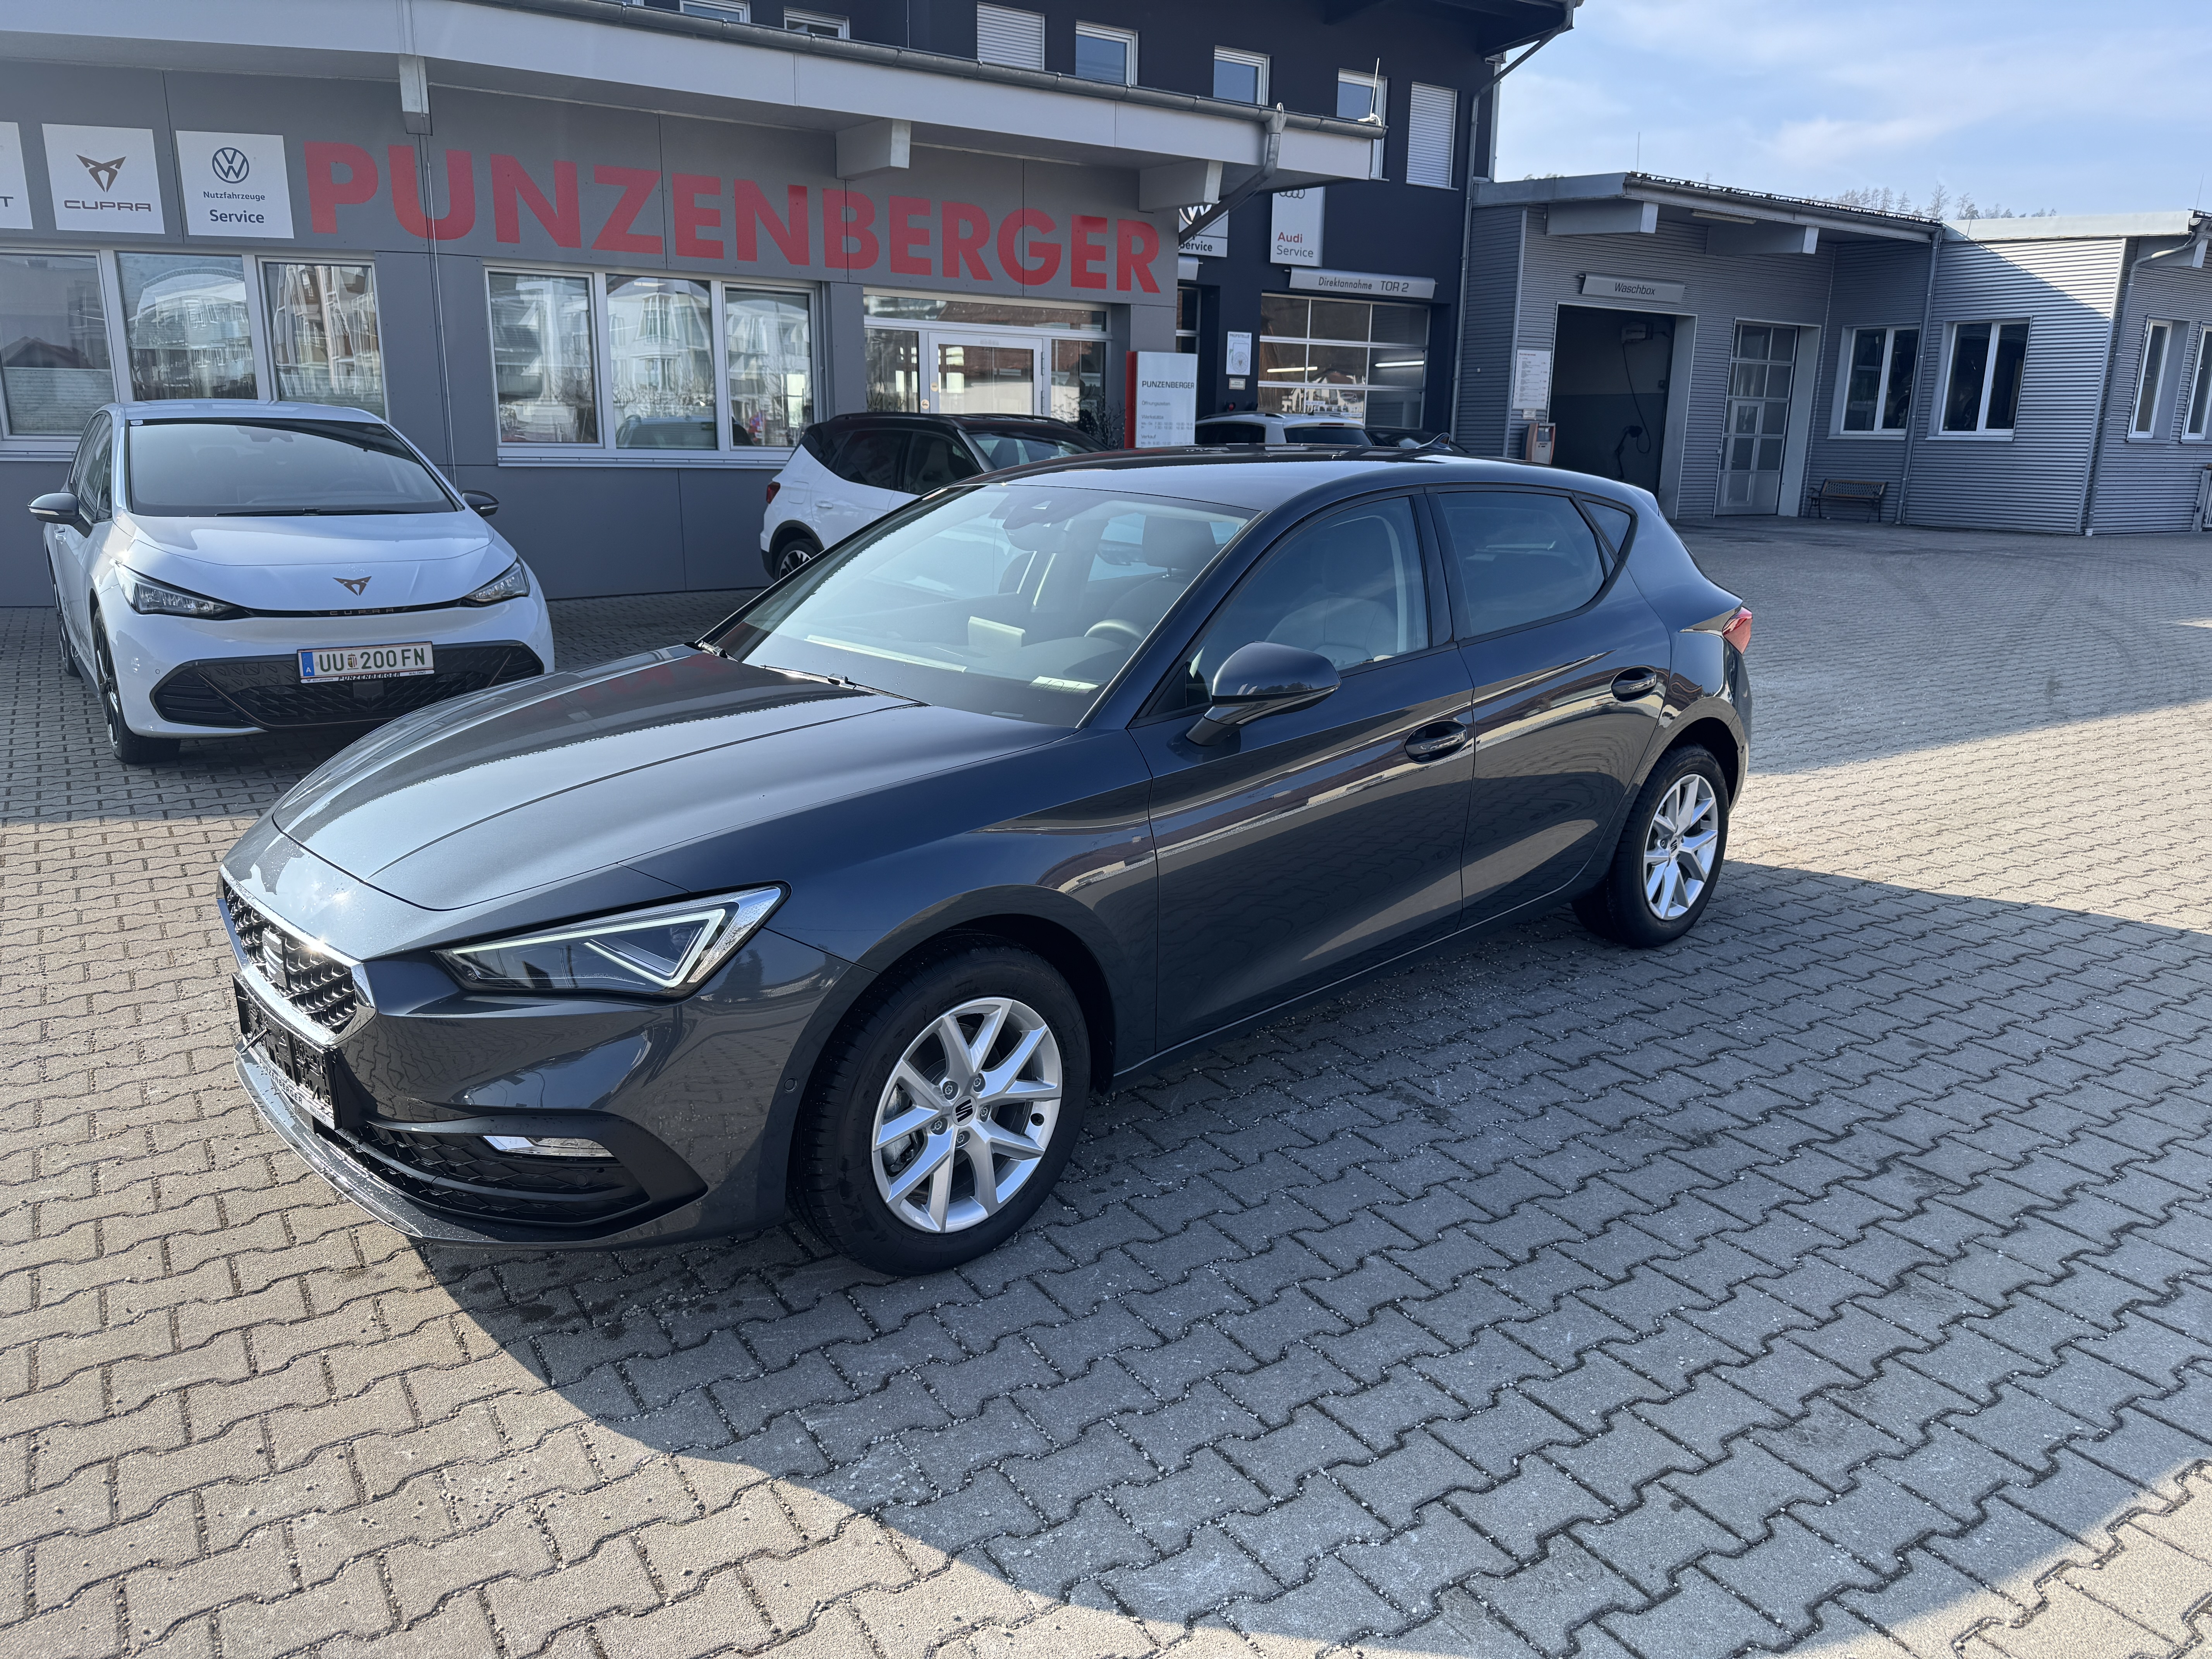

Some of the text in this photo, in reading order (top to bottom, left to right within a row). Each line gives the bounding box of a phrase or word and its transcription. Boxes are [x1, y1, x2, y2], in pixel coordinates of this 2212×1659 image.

[203, 191, 265, 201] Nutzfahrzeuge
[64, 200, 151, 212] CUPRA
[210, 209, 264, 223] Service
[304, 141, 1161, 294] PUNZENBERGER
[1278, 232, 1303, 244] Audi
[1276, 245, 1314, 258] Service
[1319, 276, 1409, 292] Direktannahme TOR 2
[1615, 282, 1656, 295] Waschbox
[1142, 380, 1194, 389] PUNZENBERGER
[319, 653, 344, 672] UU
[309, 1104, 326, 1121] WALDING
